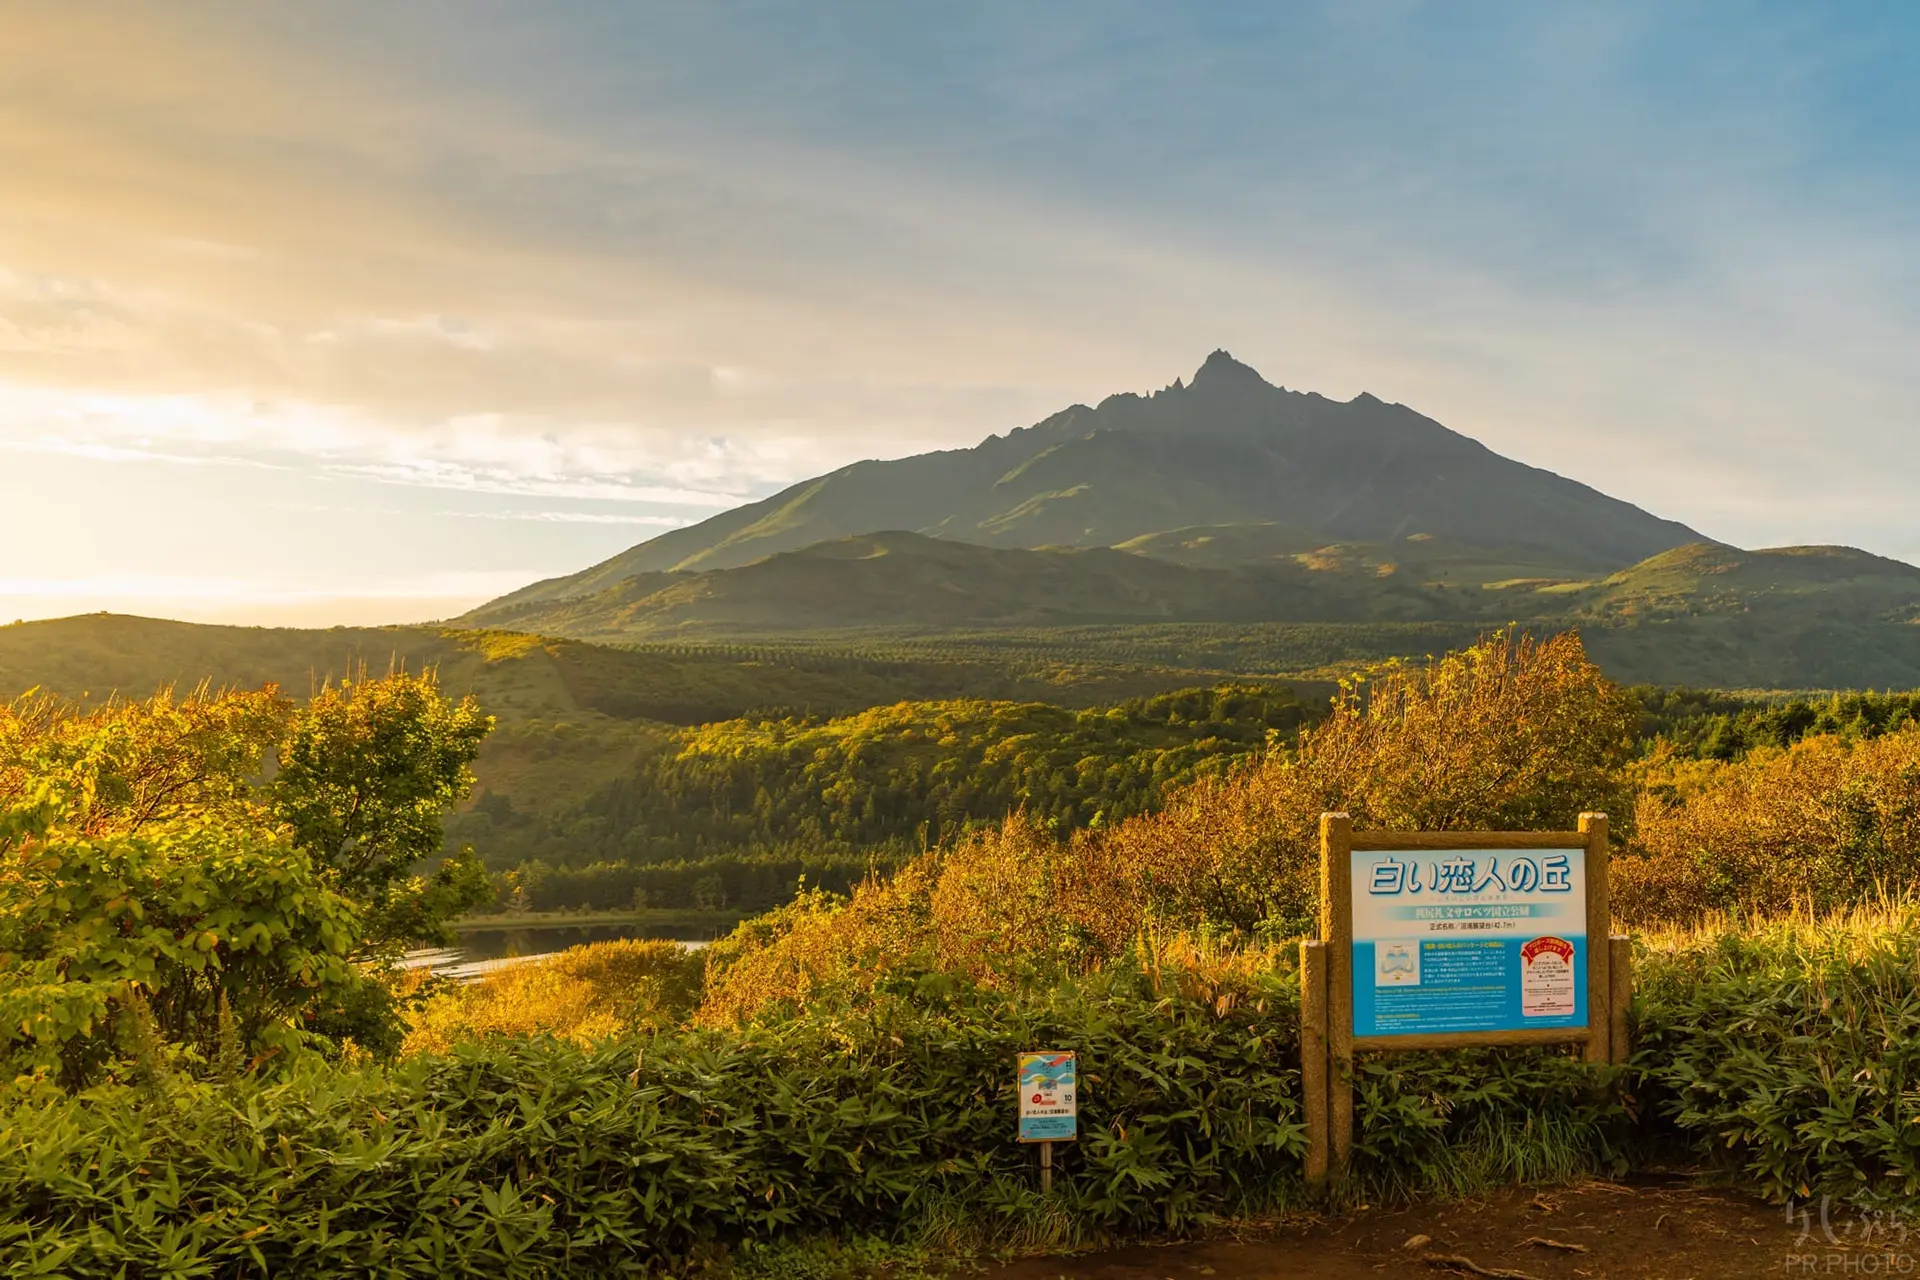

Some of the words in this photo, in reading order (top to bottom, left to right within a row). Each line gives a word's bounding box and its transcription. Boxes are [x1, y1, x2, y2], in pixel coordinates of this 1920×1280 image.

[1369, 855, 1572, 894] 白い恋人の丘
